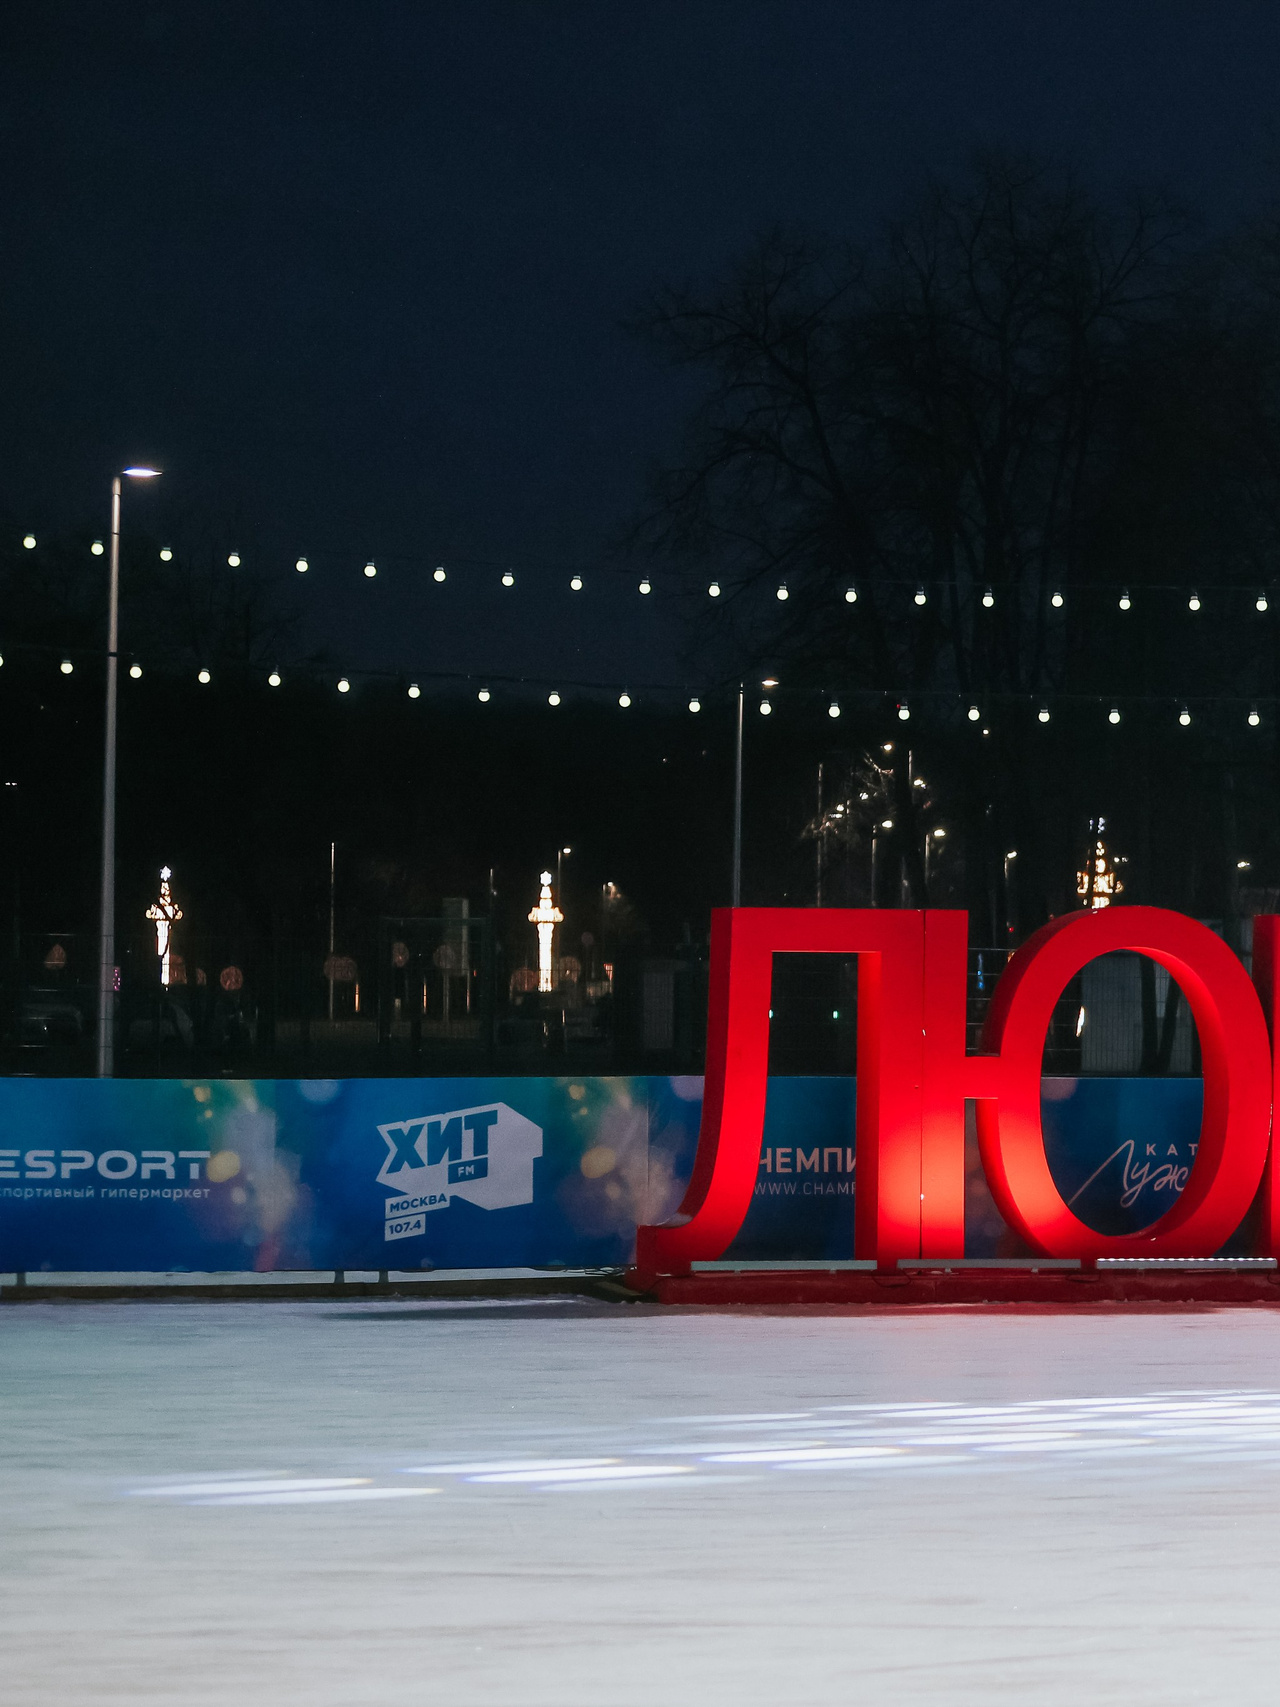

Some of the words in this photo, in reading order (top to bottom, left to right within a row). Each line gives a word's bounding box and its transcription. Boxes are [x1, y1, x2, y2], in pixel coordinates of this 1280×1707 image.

[385, 1109, 498, 1175] ХИТ
[0, 1149, 211, 1180] ESPORT
[457, 1164, 475, 1177] FM
[0, 1185, 95, 1201] портивный
[101, 1187, 210, 1201] гипермаркет
[389, 1193, 448, 1213] МОСКВА
[389, 1219, 422, 1235] 107.4
